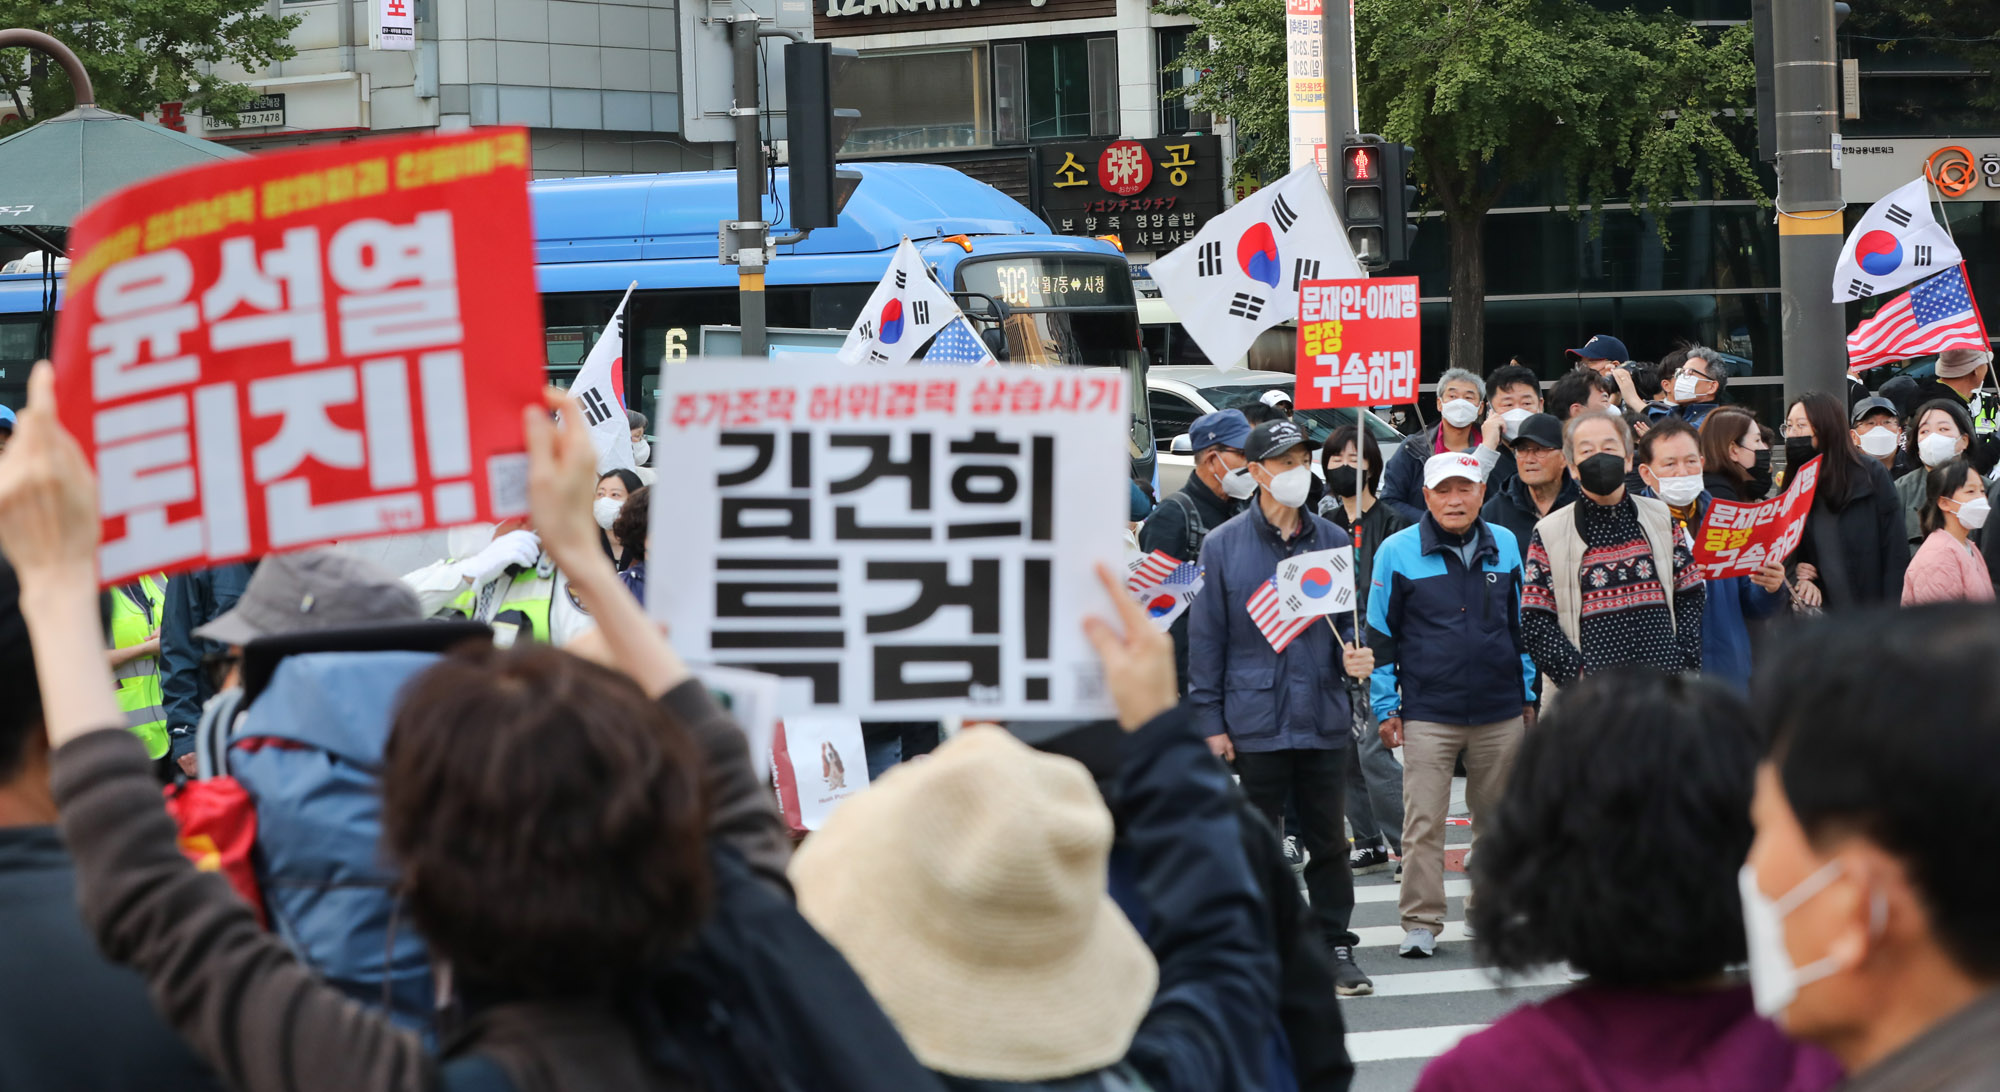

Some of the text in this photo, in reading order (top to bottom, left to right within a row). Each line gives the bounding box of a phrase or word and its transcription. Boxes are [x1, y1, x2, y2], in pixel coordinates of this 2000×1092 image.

[826, 0, 980, 17] IZAKA
[1053, 152, 1089, 188] 소
[1106, 145, 1143, 186] 粥
[1160, 144, 1196, 187] 공
[1842, 146, 1894, 155] 한화금융네트워크
[1136, 212, 1196, 229] 영양솥밥
[1030, 275, 1069, 294] 신월7동
[1084, 275, 1105, 294] 시청
[1302, 283, 1417, 322] 문재인·이재명
[88, 208, 464, 403] 윤석열
[1303, 320, 1343, 357] 당장
[1313, 350, 1417, 403] 구속하라
[672, 377, 1121, 429] 주가조작 허위경력 상습사기
[95, 349, 476, 582] 퇴진!
[716, 430, 1055, 542] 김건희
[1704, 527, 1753, 551] 당장
[710, 557, 1053, 705] 특검!
